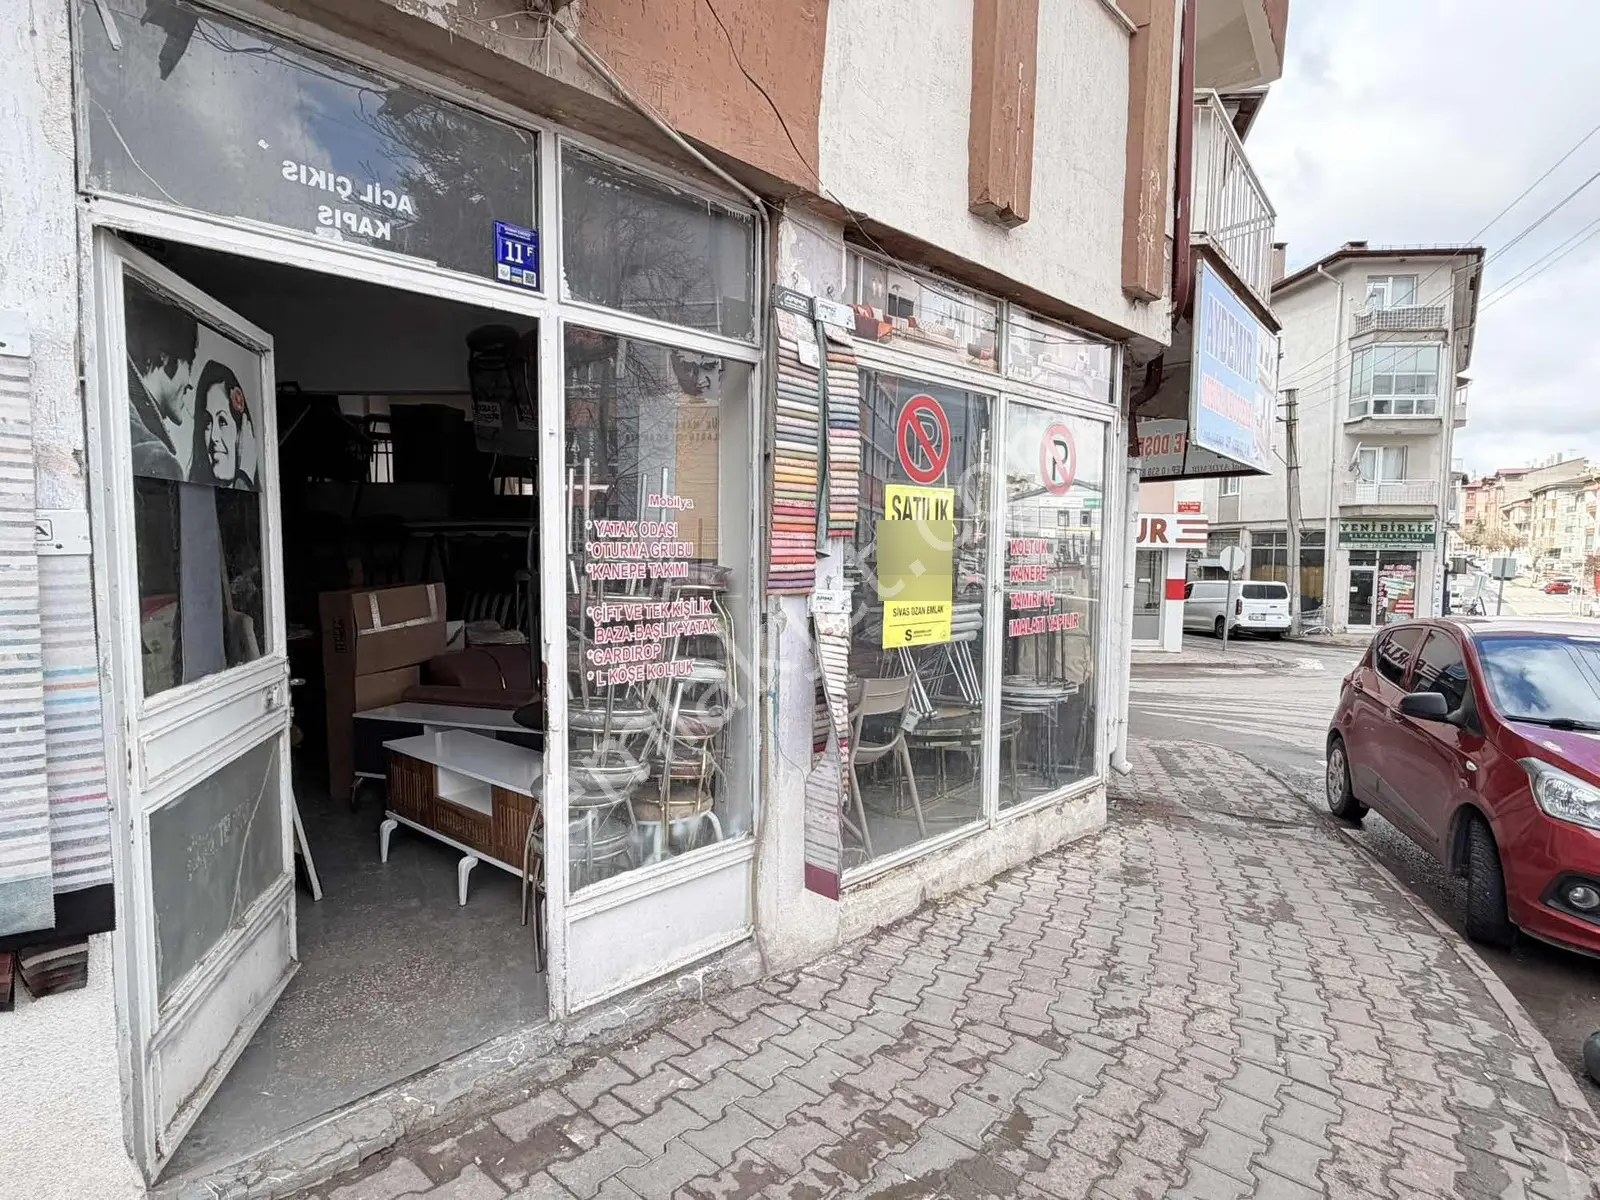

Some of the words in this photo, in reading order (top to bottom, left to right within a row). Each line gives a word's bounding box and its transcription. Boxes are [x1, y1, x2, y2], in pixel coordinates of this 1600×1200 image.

[505, 240, 524, 264] 11
[648, 494, 695, 511] Mobilya
[891, 494, 949, 520] SATILIK
[593, 520, 638, 538] YATAK
[640, 522, 678, 538] ODASI
[1340, 520, 1376, 532] YENİ
[1380, 520, 1434, 532] BİRLİK
[591, 542, 649, 559] OTURMA
[651, 541, 694, 558] GRUBU
[1009, 537, 1048, 556] KOLTUK
[592, 562, 647, 580] KANEPE
[648, 561, 689, 579] TAKIMI
[1009, 564, 1048, 583] KANEPE
[1042, 590, 1055, 607] VE
[592, 602, 622, 626] ÇİFT
[624, 603, 644, 620] VE
[645, 601, 670, 619] TEK
[670, 596, 713, 620] KİŞİLİK
[892, 606, 911, 618] SİVAS
[926, 604, 944, 615] EMLAK
[1046, 612, 1080, 632] YAPILIR
[592, 643, 662, 666] GARDIROP
[596, 669, 606, 687] L
[608, 663, 645, 686] KÖŞE
[646, 658, 696, 681] KOLTUK
